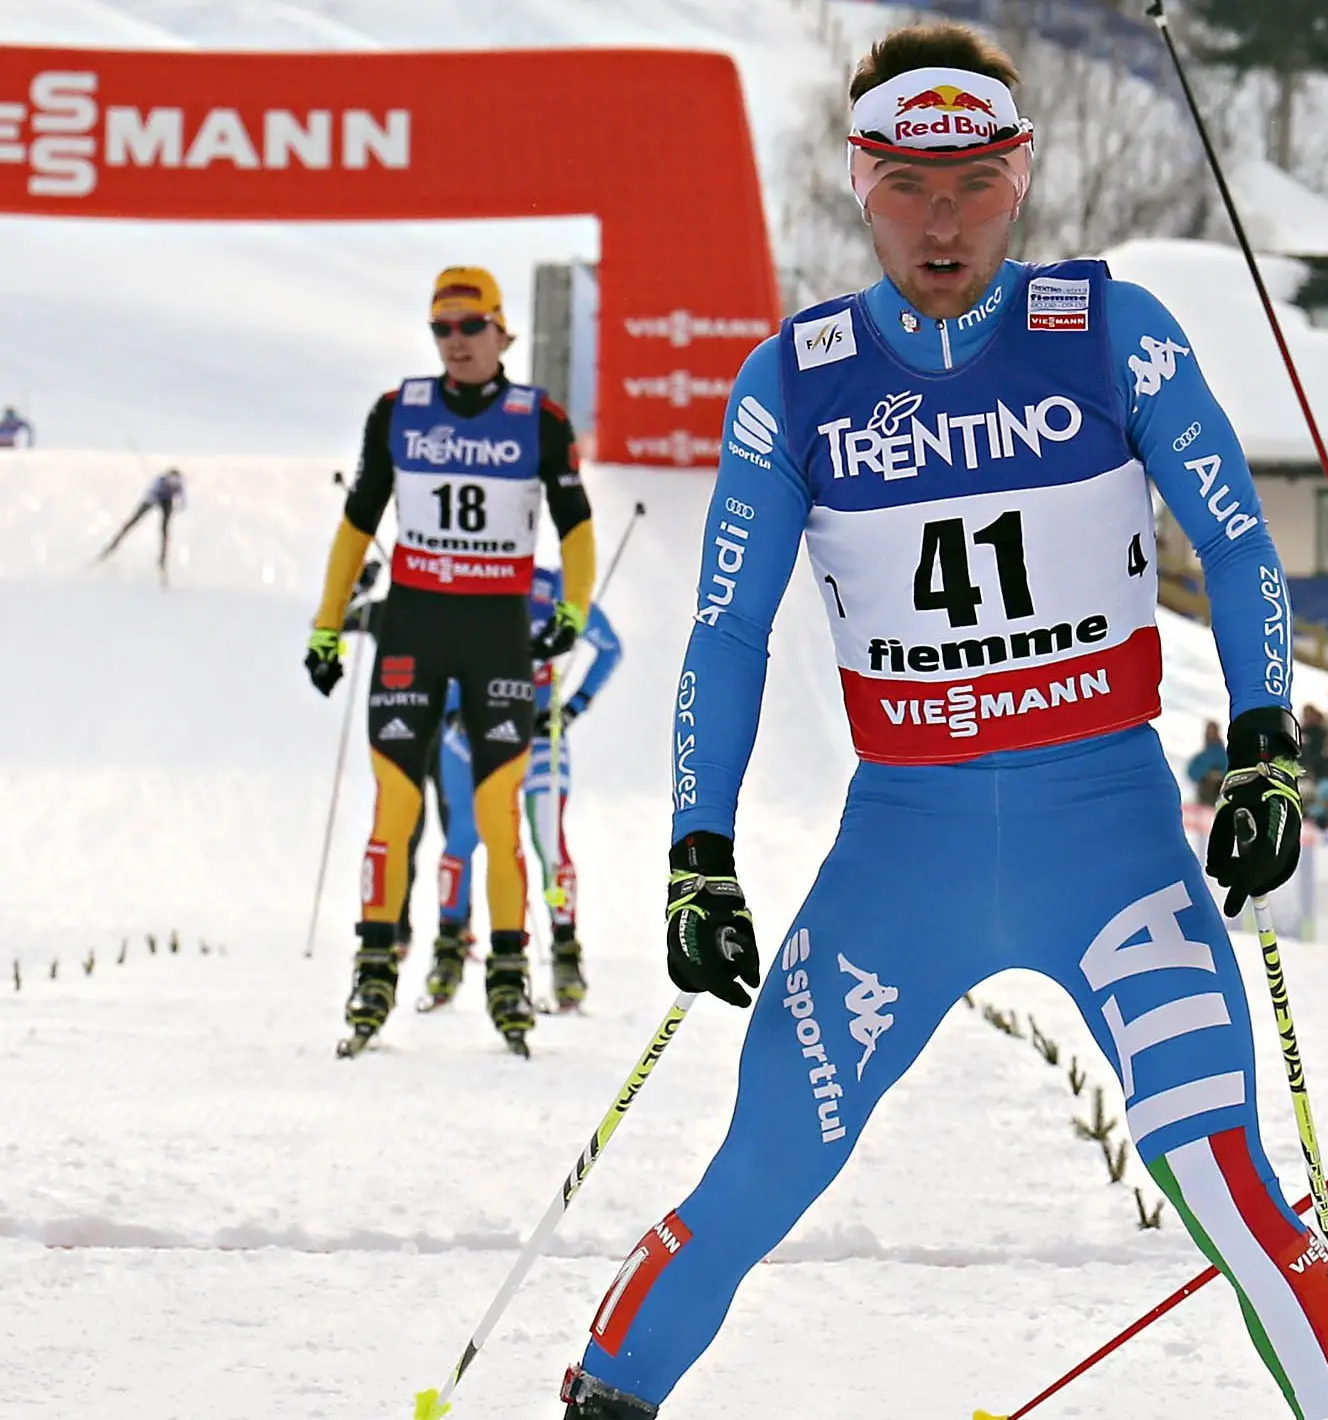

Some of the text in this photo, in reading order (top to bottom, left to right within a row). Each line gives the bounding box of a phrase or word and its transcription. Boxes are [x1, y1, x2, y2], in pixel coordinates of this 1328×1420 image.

[895, 114, 998, 141] Red Bull
[957, 286, 1003, 331] mico
[1031, 316, 1085, 328] VIESSMANN
[403, 430, 521, 465] TRENTINO
[817, 395, 1082, 481] TRENTINO
[432, 485, 486, 532] 18
[405, 530, 517, 554] fiemme
[1127, 532, 1149, 578] 4
[404, 555, 516, 583] VIESSMANN
[692, 520, 749, 627] Audi
[912, 510, 1036, 628] 41
[867, 613, 1108, 673] fiemme
[677, 670, 697, 727] GDF
[880, 668, 1111, 738] VIESSMANN
[1079, 879, 1246, 1143] ITA
[782, 969, 847, 1144] sportful
